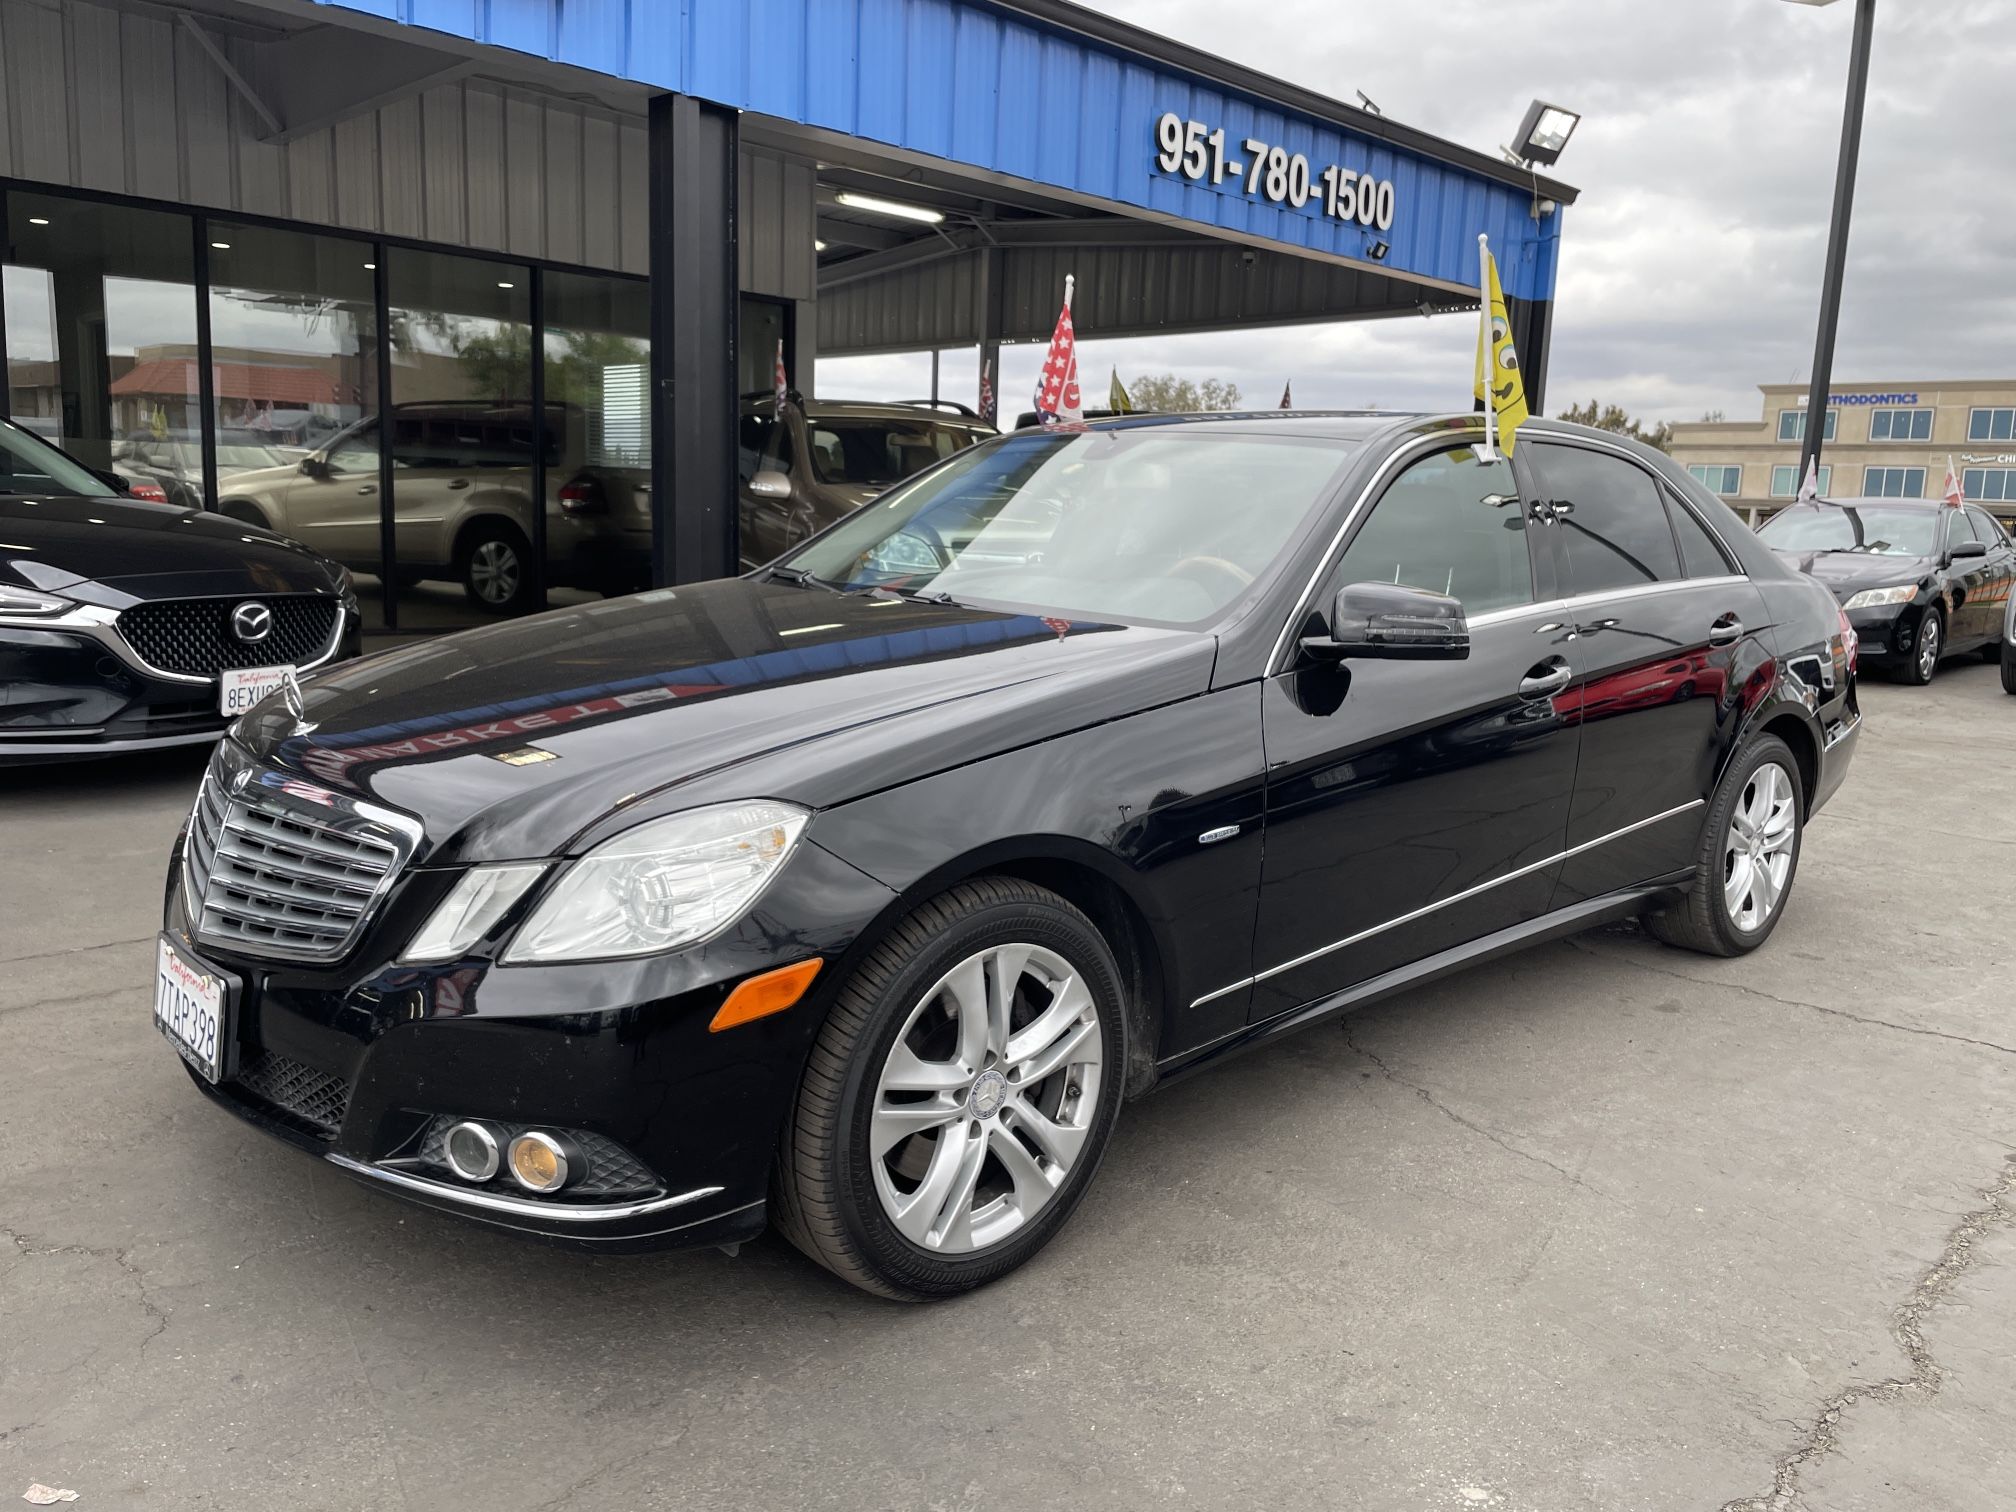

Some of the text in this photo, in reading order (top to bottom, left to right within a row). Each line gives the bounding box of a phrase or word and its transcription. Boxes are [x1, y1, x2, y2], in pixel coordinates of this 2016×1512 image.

[1157, 112, 1395, 232] 951-780-1500
[1827, 393, 1919, 405] THODONTICS
[237, 671, 282, 685] California
[228, 684, 282, 709] 8EXU
[160, 973, 216, 1062] 7TAP398
